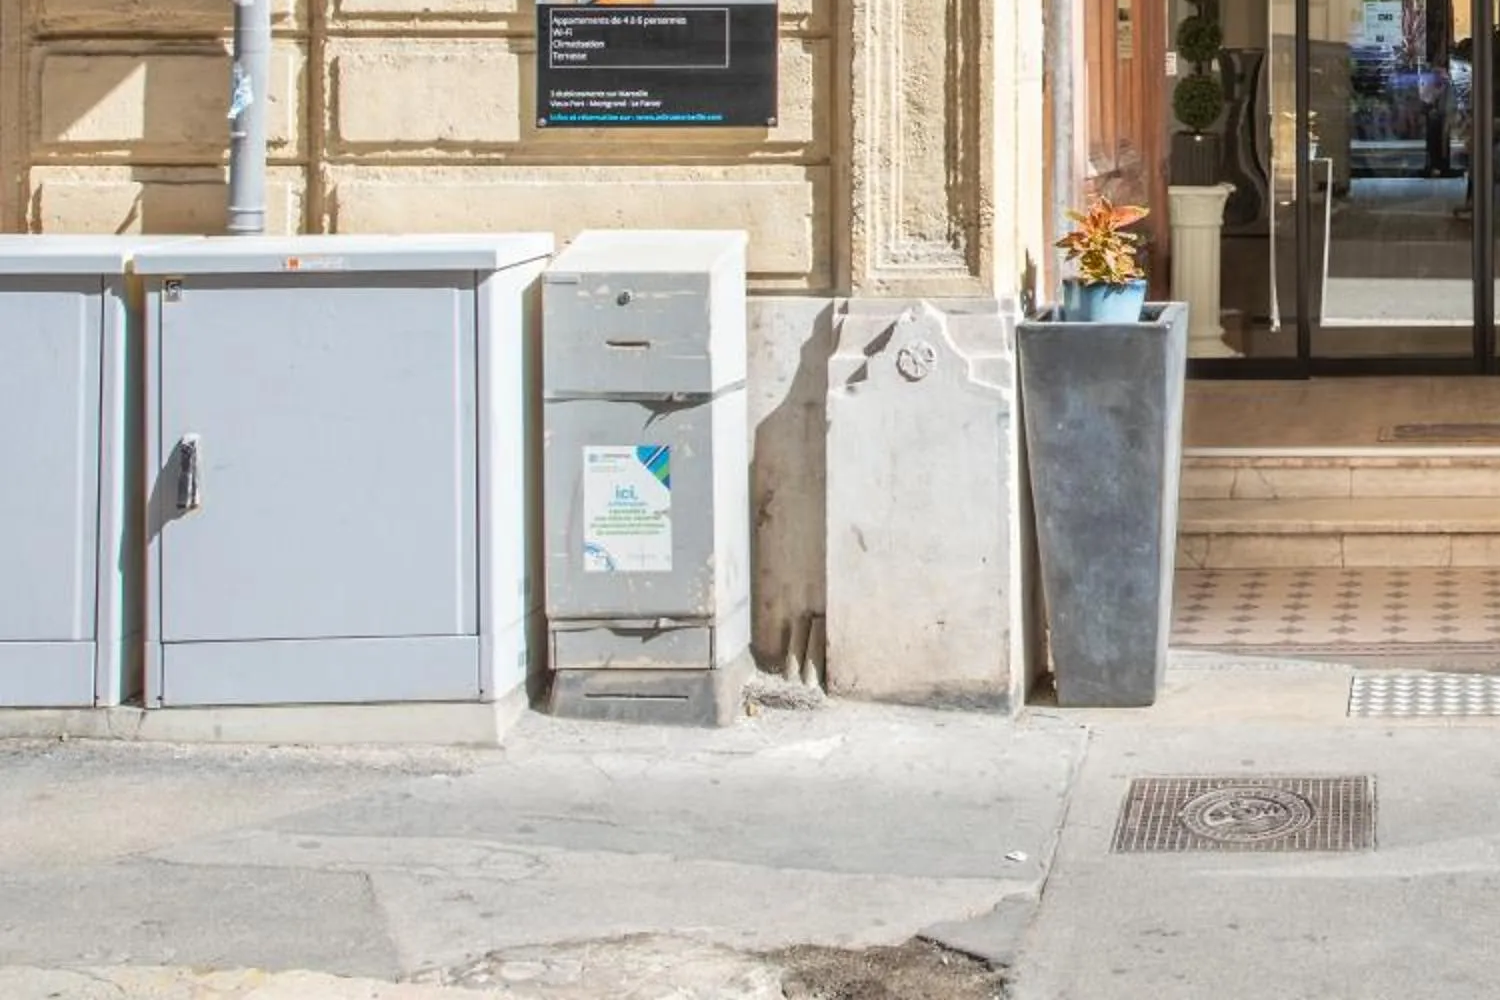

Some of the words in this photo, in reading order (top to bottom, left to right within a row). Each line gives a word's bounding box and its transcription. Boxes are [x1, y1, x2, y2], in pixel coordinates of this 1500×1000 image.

[552, 16, 609, 26] Appartements
[610, 17, 621, 25] de
[623, 17, 629, 25] 4
[644, 17, 687, 28] personnes
[552, 40, 605, 49] Climatisation
